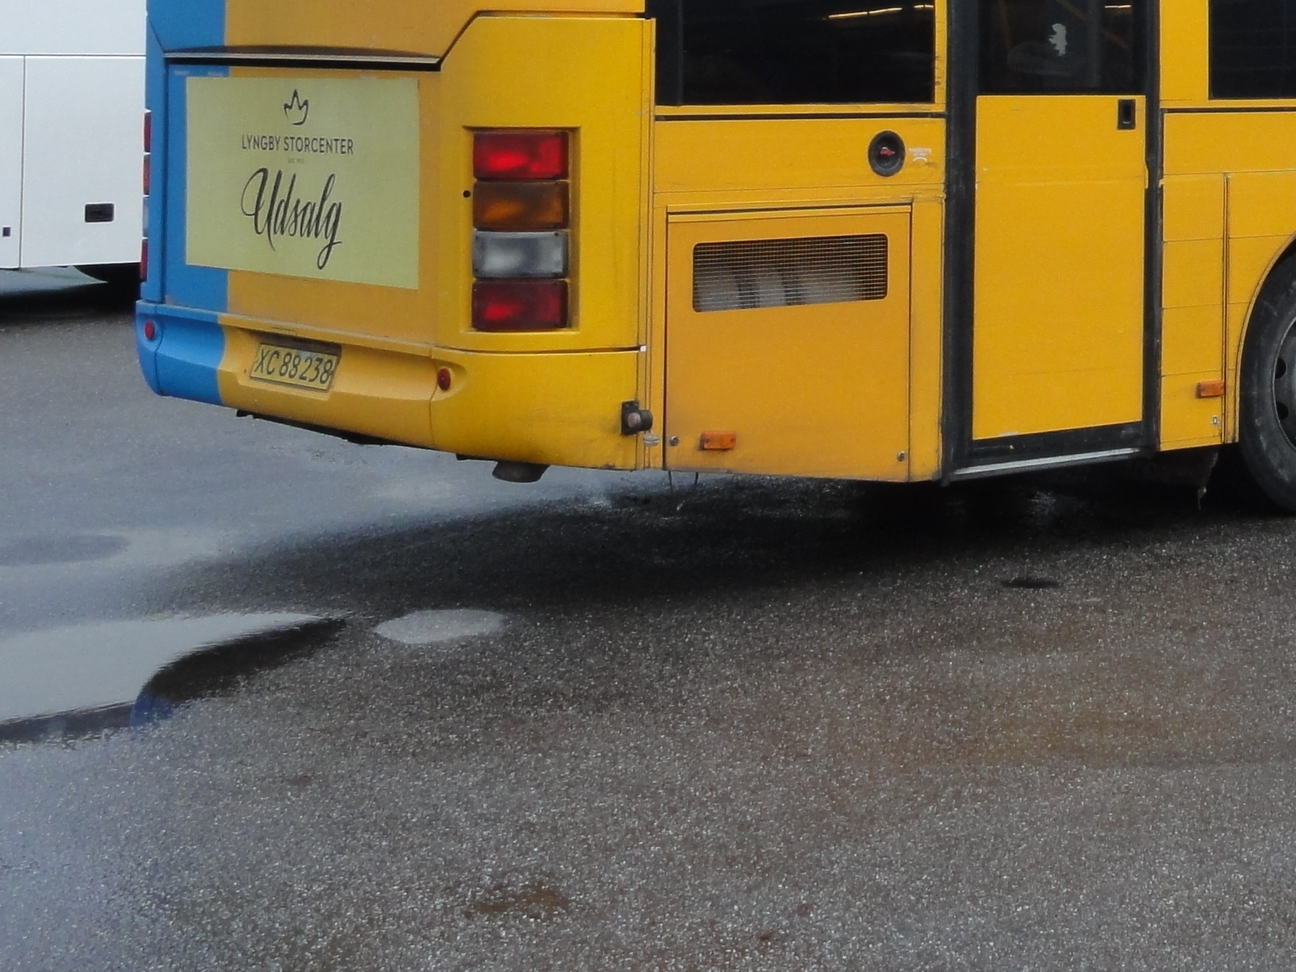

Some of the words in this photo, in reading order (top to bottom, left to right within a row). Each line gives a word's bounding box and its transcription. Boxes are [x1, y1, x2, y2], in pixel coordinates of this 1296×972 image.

[242, 134, 281, 151] LYNGBY
[284, 136, 354, 155] STORCENTER
[241, 167, 343, 270] Udsalg
